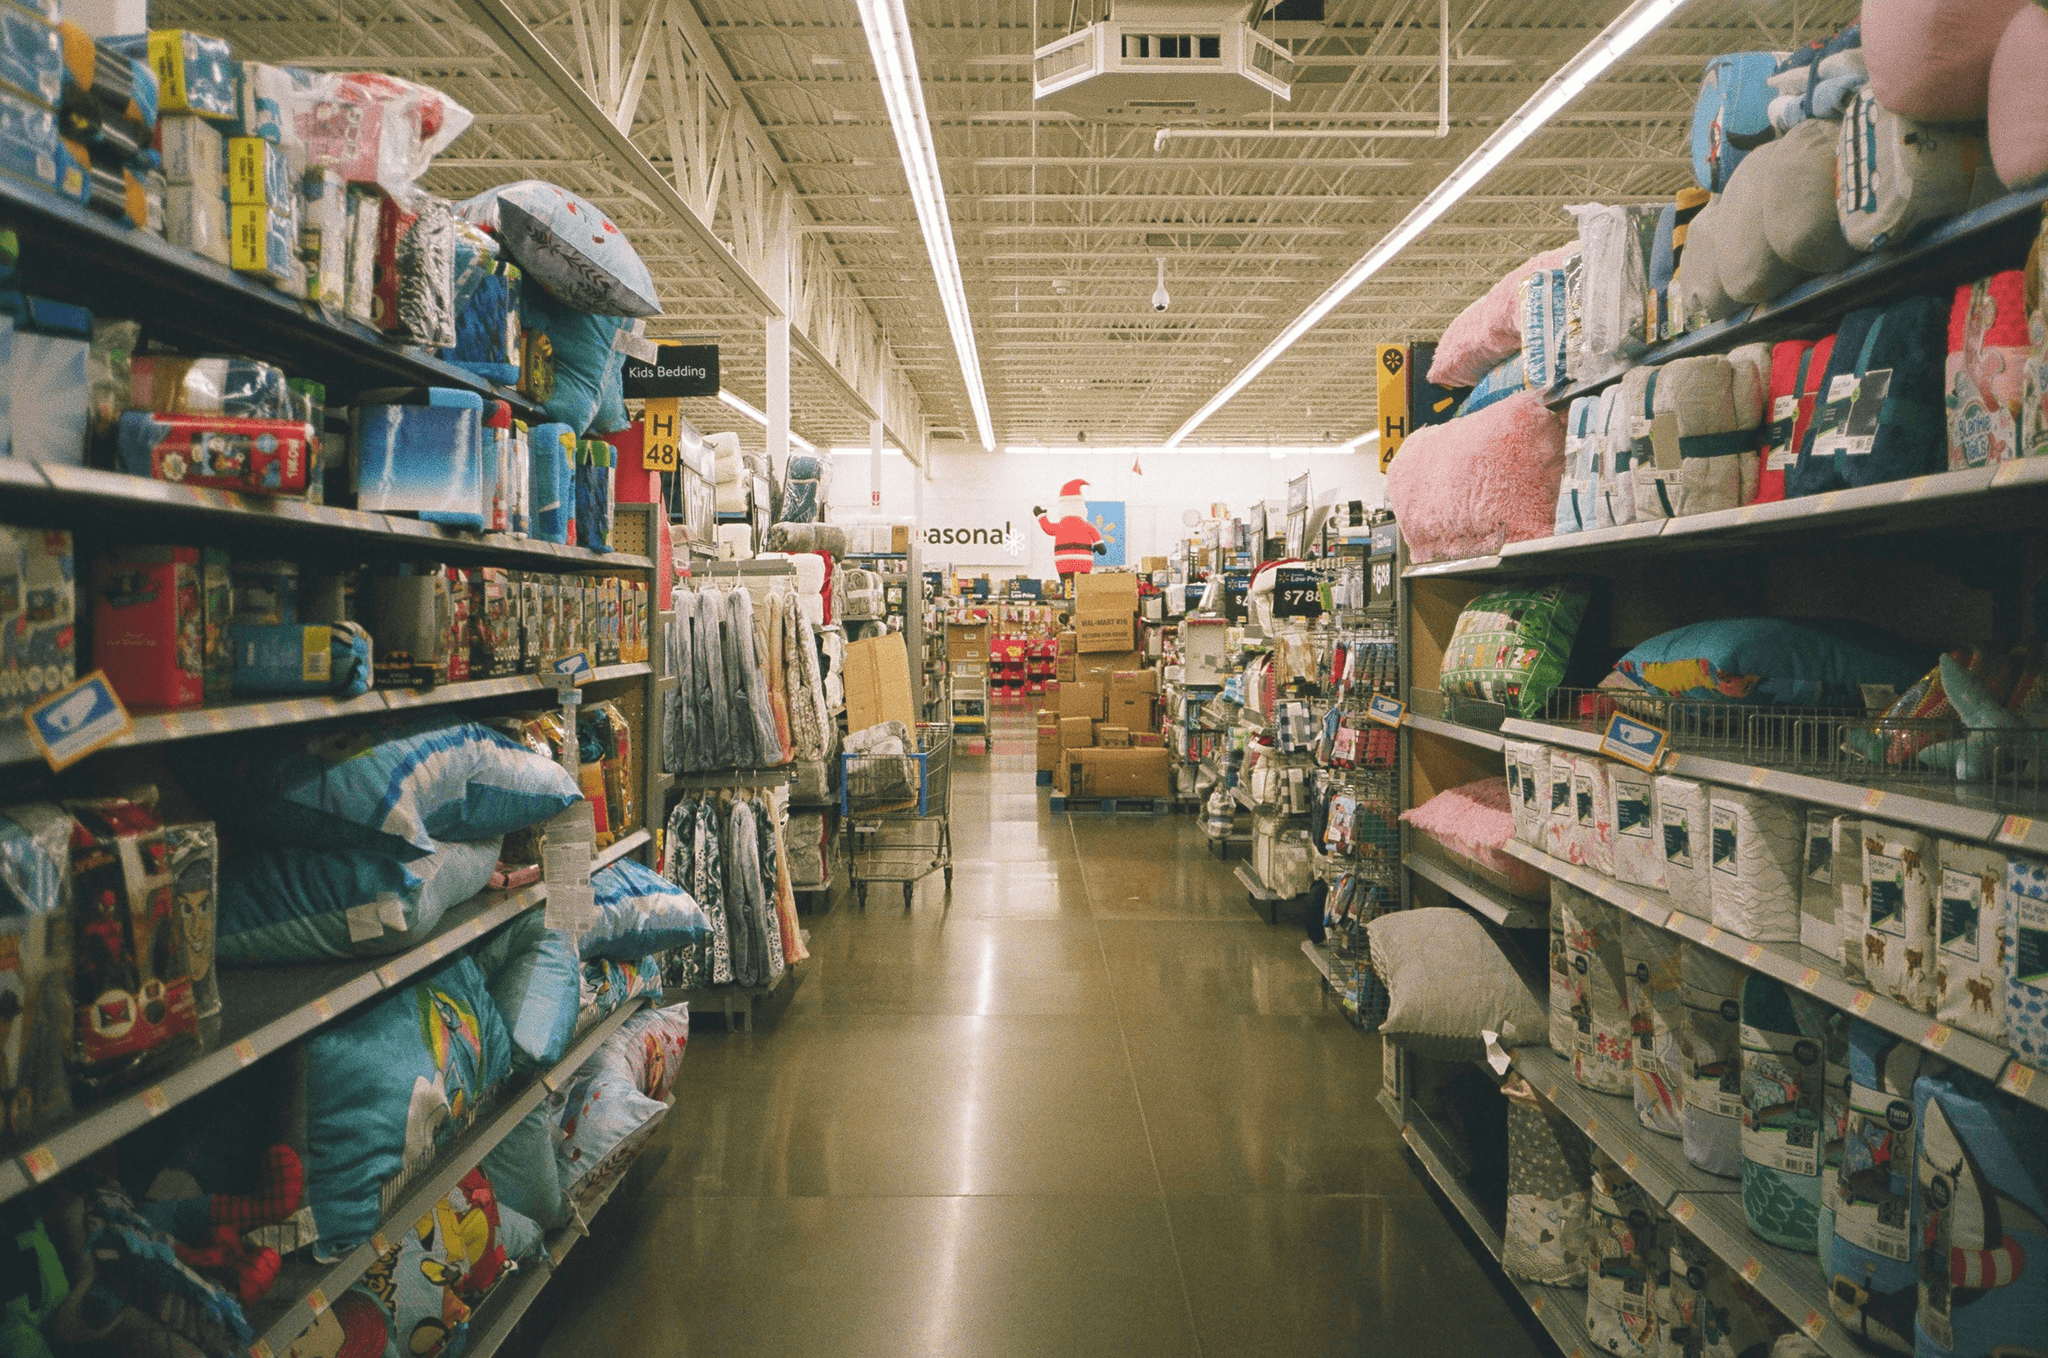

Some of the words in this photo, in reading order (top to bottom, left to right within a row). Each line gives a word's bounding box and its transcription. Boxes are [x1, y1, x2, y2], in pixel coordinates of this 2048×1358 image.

[629, 367, 654, 378] Kids
[657, 366, 706, 379] Bedding
[653, 414, 673, 437] H
[1386, 416, 1405, 438] H
[646, 444, 674, 465] 48
[1291, 574, 1306, 582] Low
[1889, 1108, 1909, 1119] TWIN
